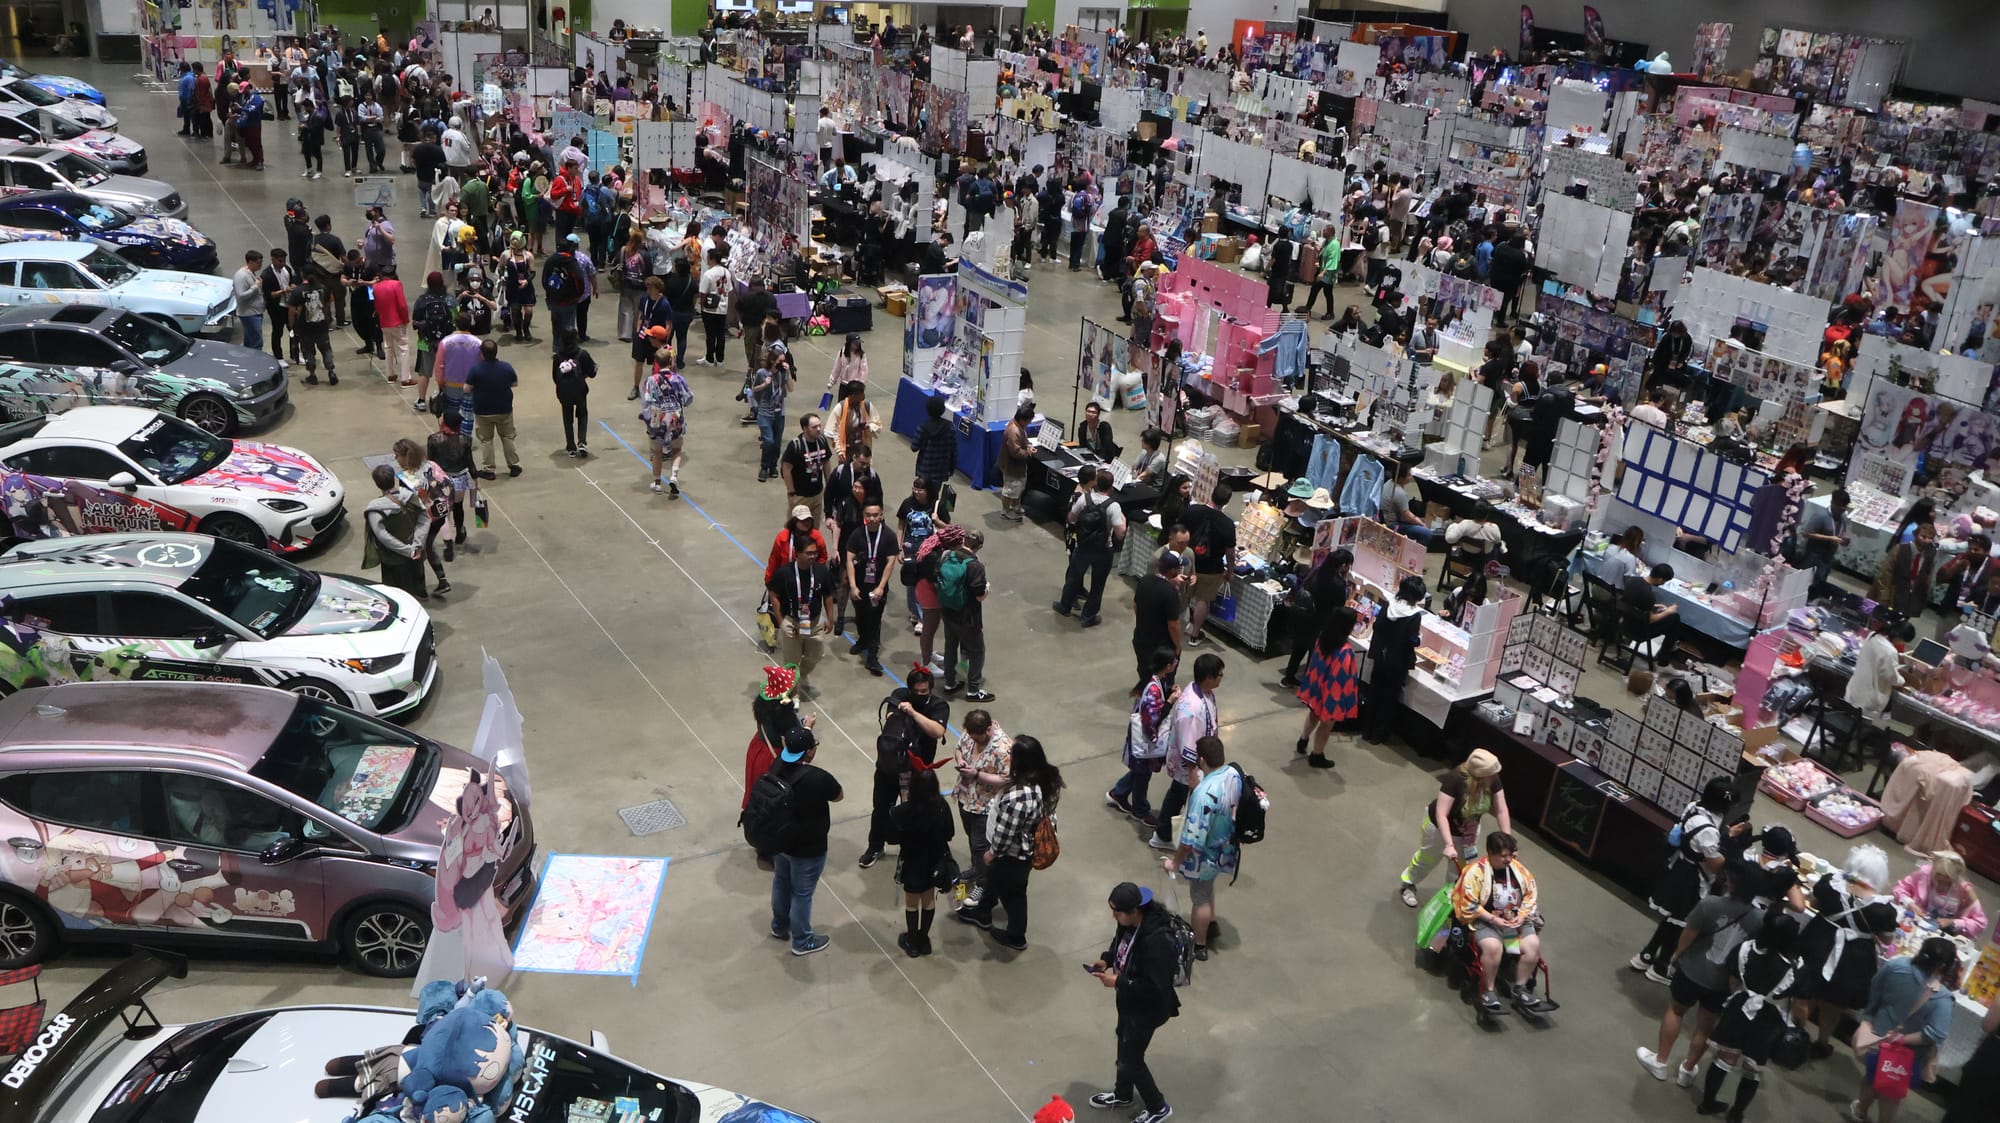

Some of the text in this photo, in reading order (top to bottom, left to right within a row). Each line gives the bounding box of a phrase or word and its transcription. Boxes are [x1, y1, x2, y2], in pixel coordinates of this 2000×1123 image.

[91, 502, 150, 519] AKUMA
[84, 513, 160, 531] NIHMUNE
[1, 1013, 77, 1089] DEKOCAR
